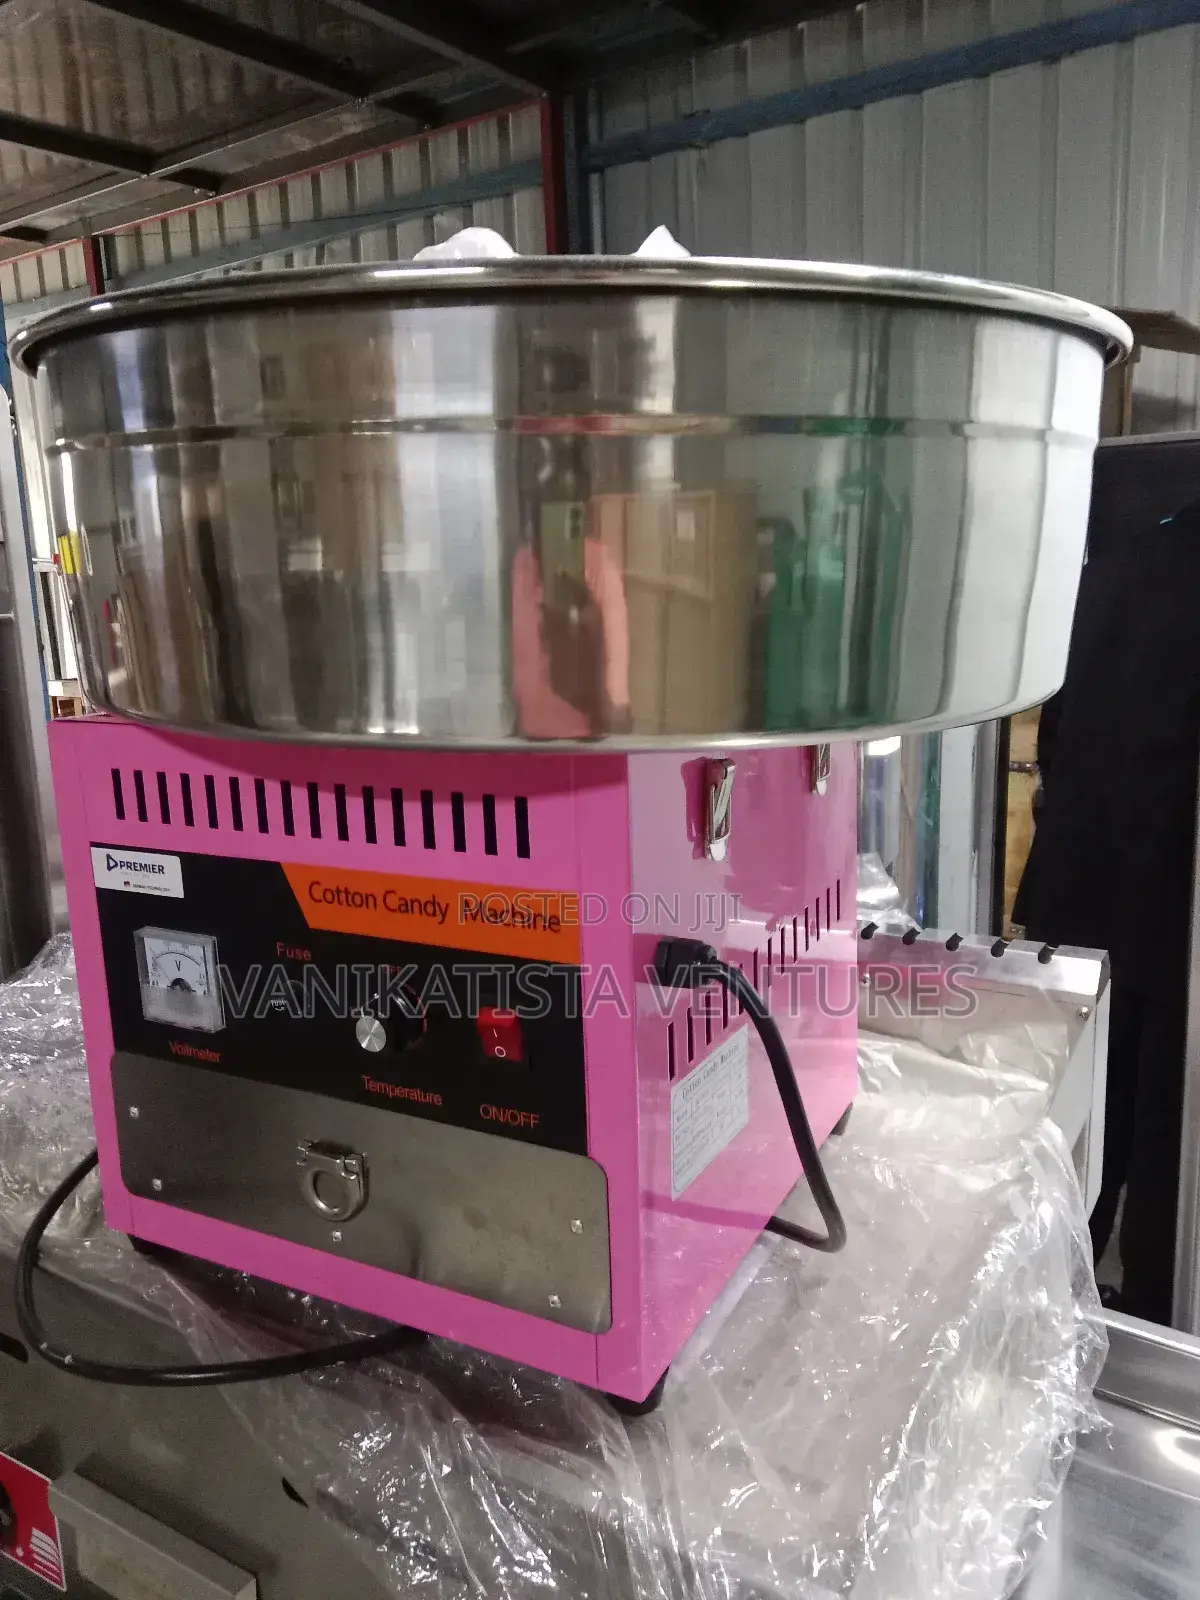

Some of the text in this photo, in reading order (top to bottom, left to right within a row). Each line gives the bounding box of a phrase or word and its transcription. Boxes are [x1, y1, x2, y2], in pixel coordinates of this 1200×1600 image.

[119, 860, 165, 874] PREMIER
[308, 881, 561, 933] Cotton Candy Machine
[276, 941, 312, 961] Fuse
[168, 1040, 221, 1063] Voltmeter
[362, 1075, 443, 1106] Temperature
[479, 1104, 540, 1130] ON/OFF
